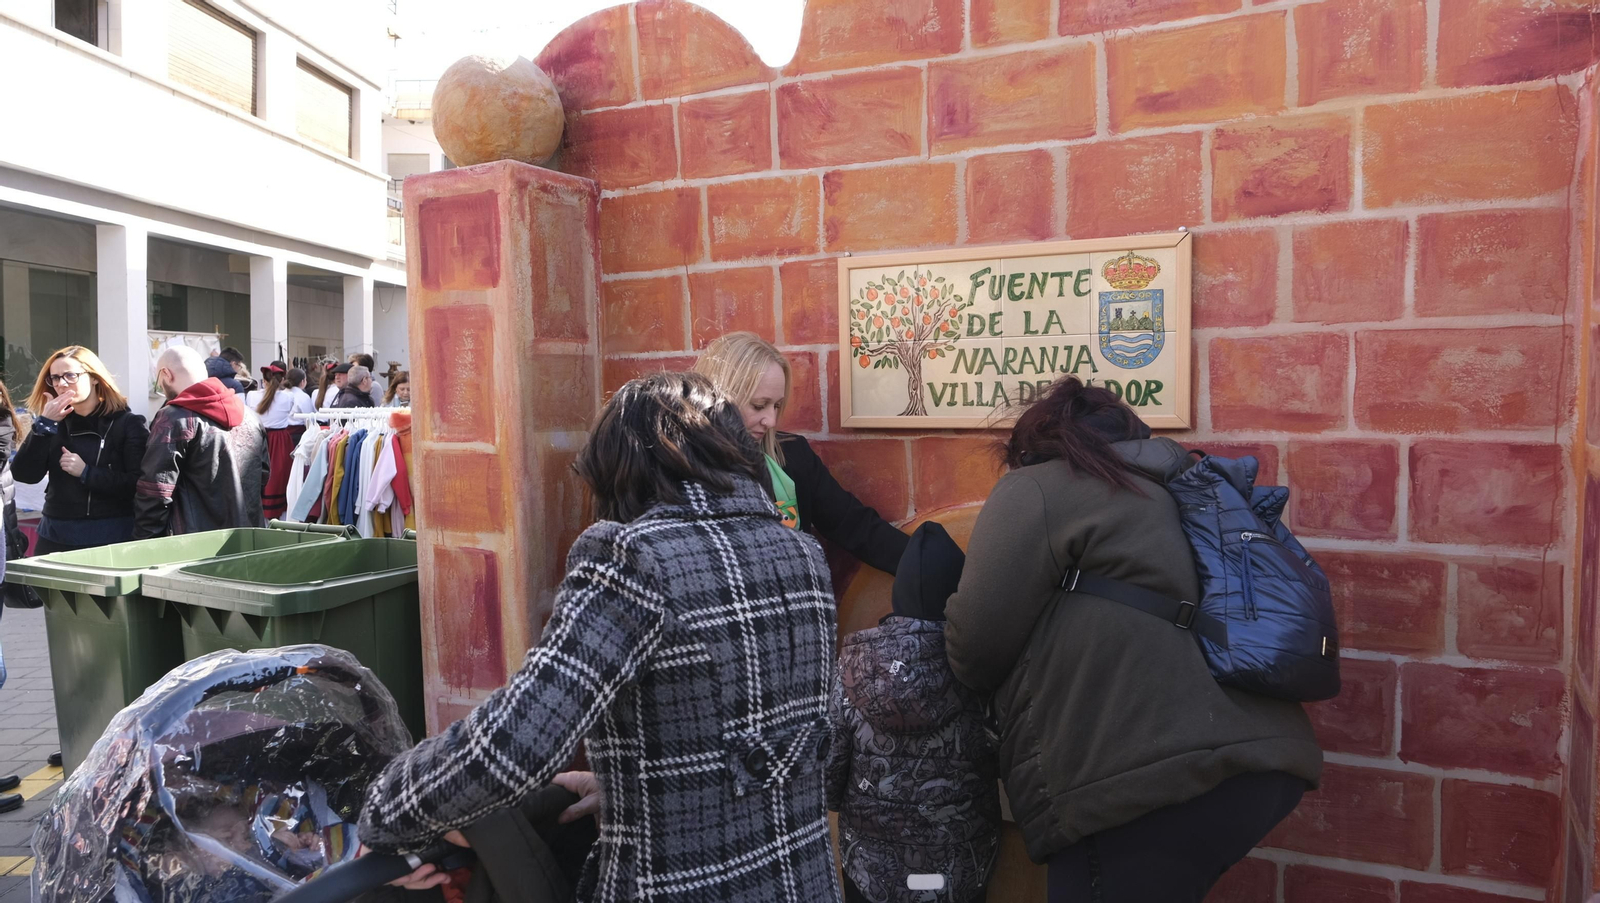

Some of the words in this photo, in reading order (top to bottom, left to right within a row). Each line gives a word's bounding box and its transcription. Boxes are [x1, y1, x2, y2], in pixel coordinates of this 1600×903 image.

[967, 266, 1093, 307] FUENTE
[965, 311, 1003, 337] DE
[1023, 309, 1067, 336] LA
[950, 344, 1099, 376] NARANJA
[926, 379, 1012, 408] VILLA
